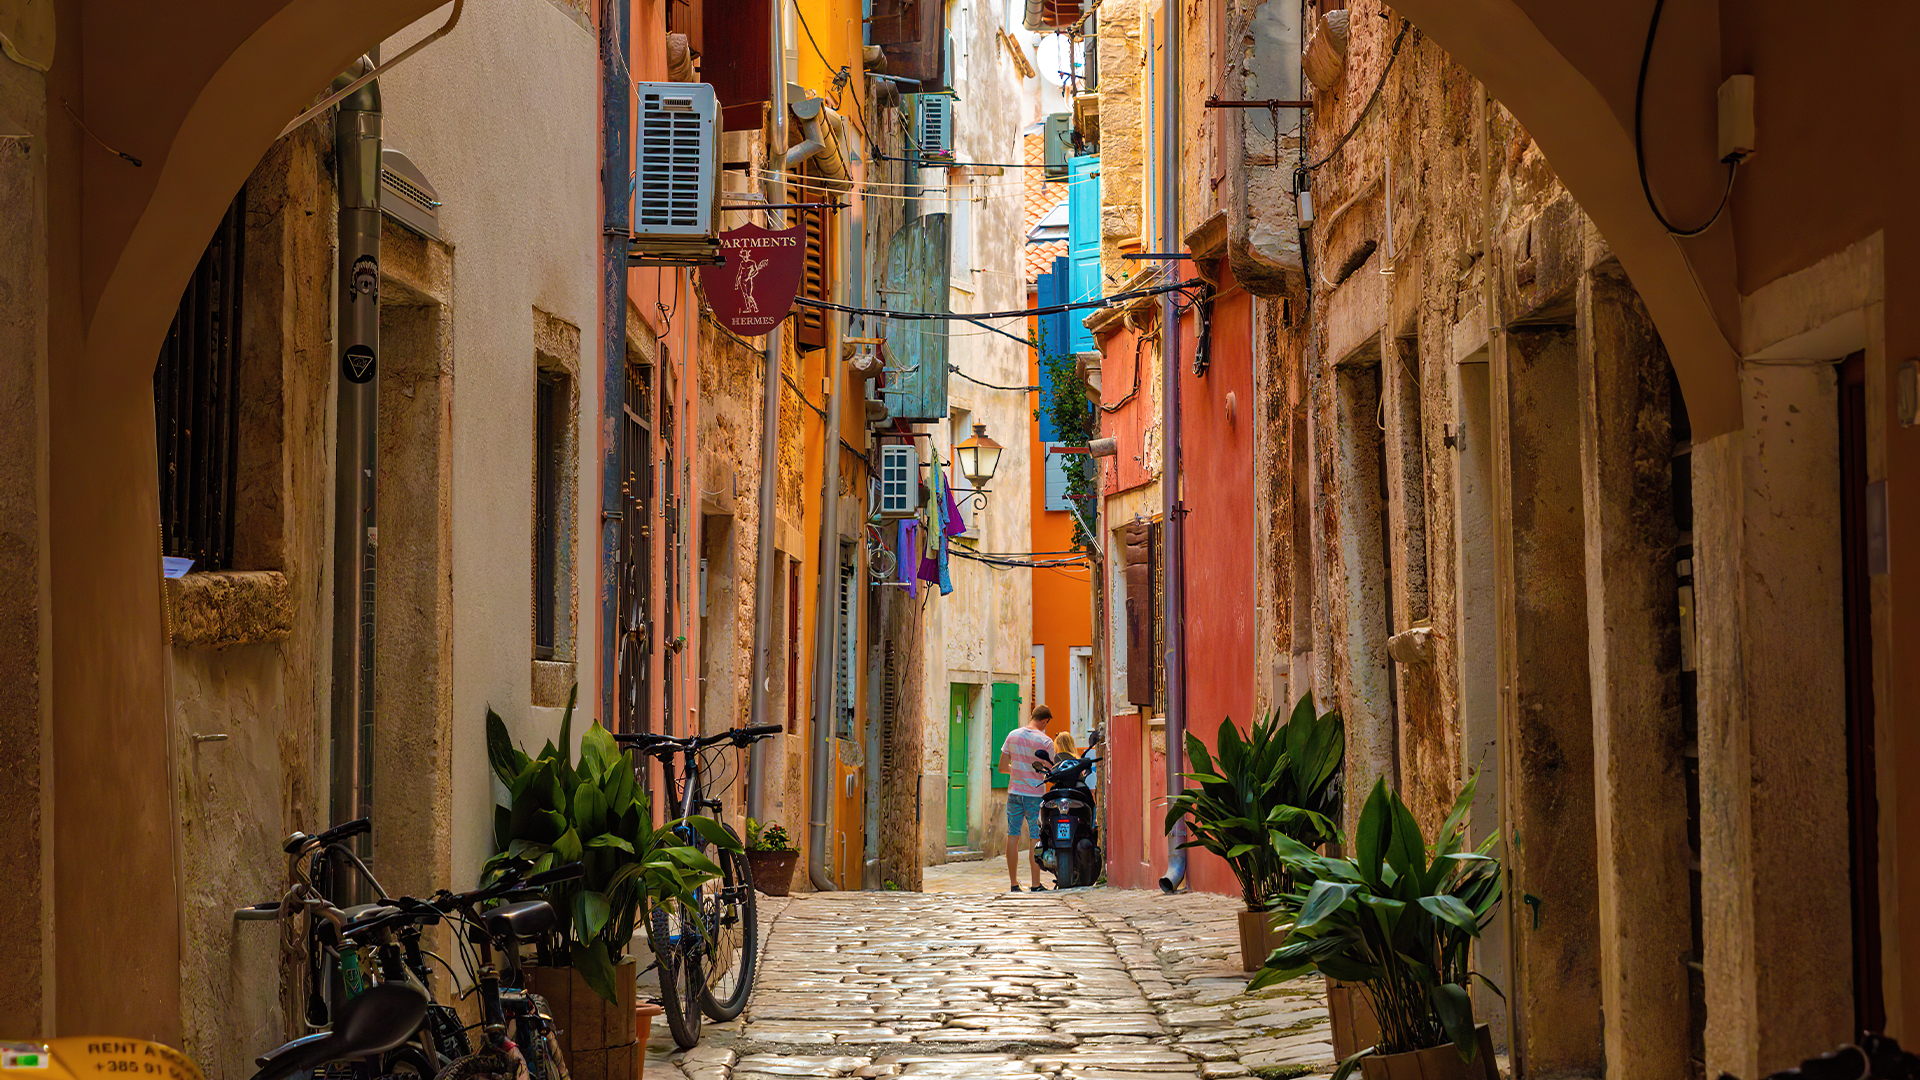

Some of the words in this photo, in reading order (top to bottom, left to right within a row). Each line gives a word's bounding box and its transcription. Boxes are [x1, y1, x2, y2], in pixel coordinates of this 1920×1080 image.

[719, 237, 797, 249] PARTMENTS
[732, 316, 775, 326] HERMES
[88, 1042, 137, 1055] RENT
